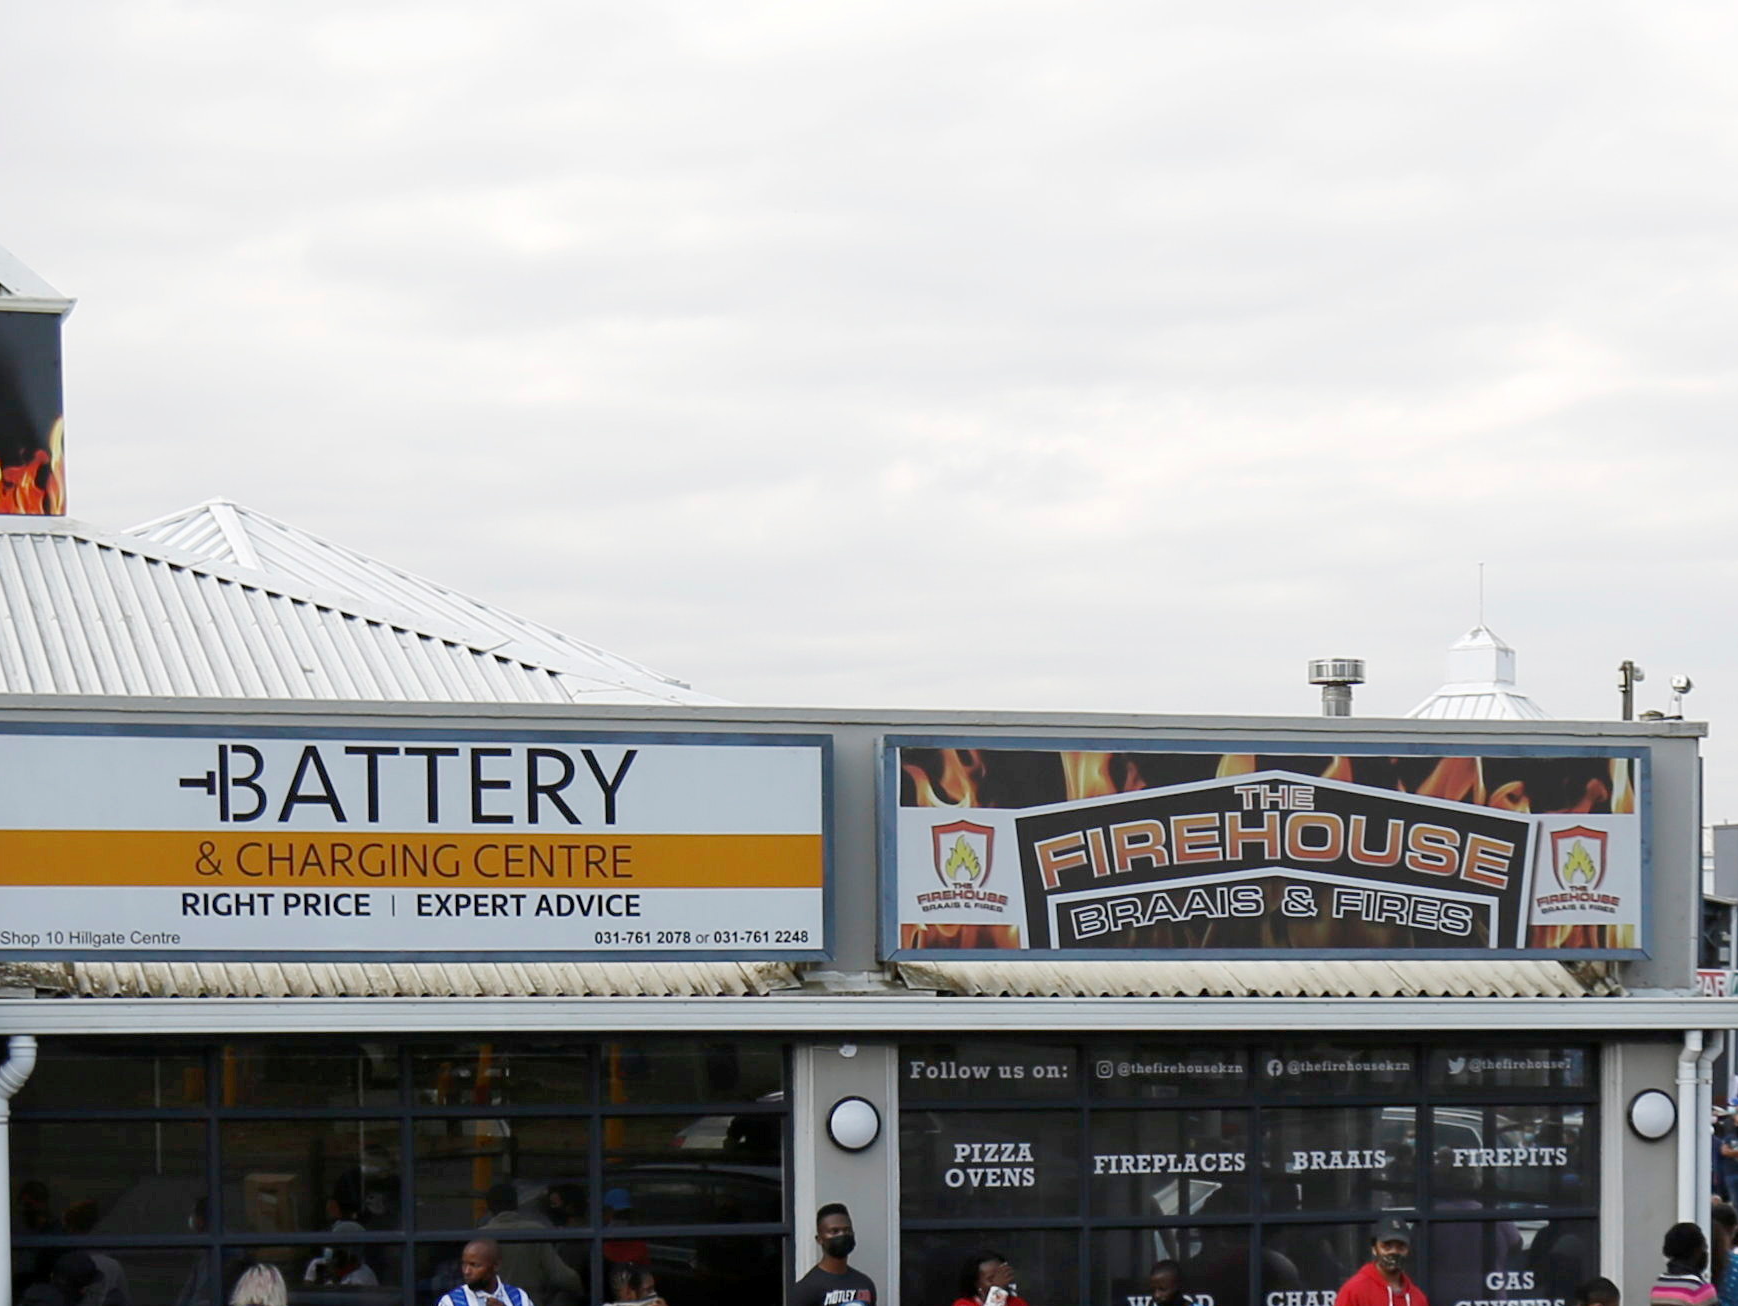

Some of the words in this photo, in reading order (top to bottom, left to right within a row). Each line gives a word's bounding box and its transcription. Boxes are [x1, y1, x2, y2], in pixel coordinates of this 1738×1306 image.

[219, 743, 637, 825] BATTERY
[1235, 784, 1314, 811] THE
[1034, 807, 1515, 890] FIREHOUSE
[195, 841, 222, 877] &
[235, 842, 460, 878] CHARGING
[473, 844, 633, 878] CENTRE
[953, 882, 973, 890] THE
[182, 893, 274, 917] RIGHT
[284, 893, 371, 917] PRICE
[416, 893, 527, 917] EXPERT
[535, 893, 641, 917] ADVICE
[917, 889, 1008, 906] FIREHOUSE
[922, 902, 960, 912] BRAAIS
[974, 902, 1003, 913] FIRES
[1536, 892, 1620, 908] FIREHOUSE
[1070, 886, 1264, 940] BRAAIS
[1282, 885, 1318, 918] &
[1332, 888, 1473, 937] FIRES
[0, 930, 42, 947] Shop
[46, 931, 64, 944] 10
[69, 930, 125, 947] Hillgate
[131, 930, 180, 945] Centre
[594, 931, 653, 945] 031-761
[657, 931, 691, 945] 2078
[695, 934, 709, 945] or
[714, 931, 771, 945] 031-761
[775, 931, 809, 945] 2248
[910, 1061, 991, 1079] Follow
[999, 1065, 1024, 1079] us
[1033, 1065, 1068, 1079] on:
[1117, 1062, 1243, 1076] @thefirehousekzn
[1287, 1059, 1410, 1075] @thefirehousekzn
[954, 1143, 1034, 1163] PIZZA
[1293, 1150, 1387, 1170] BRAAIS
[1453, 1147, 1568, 1167] FIREPITS
[1094, 1153, 1246, 1174] FIREPLACES
[945, 1168, 1035, 1188] OVENS
[1485, 1272, 1535, 1290] GAS
